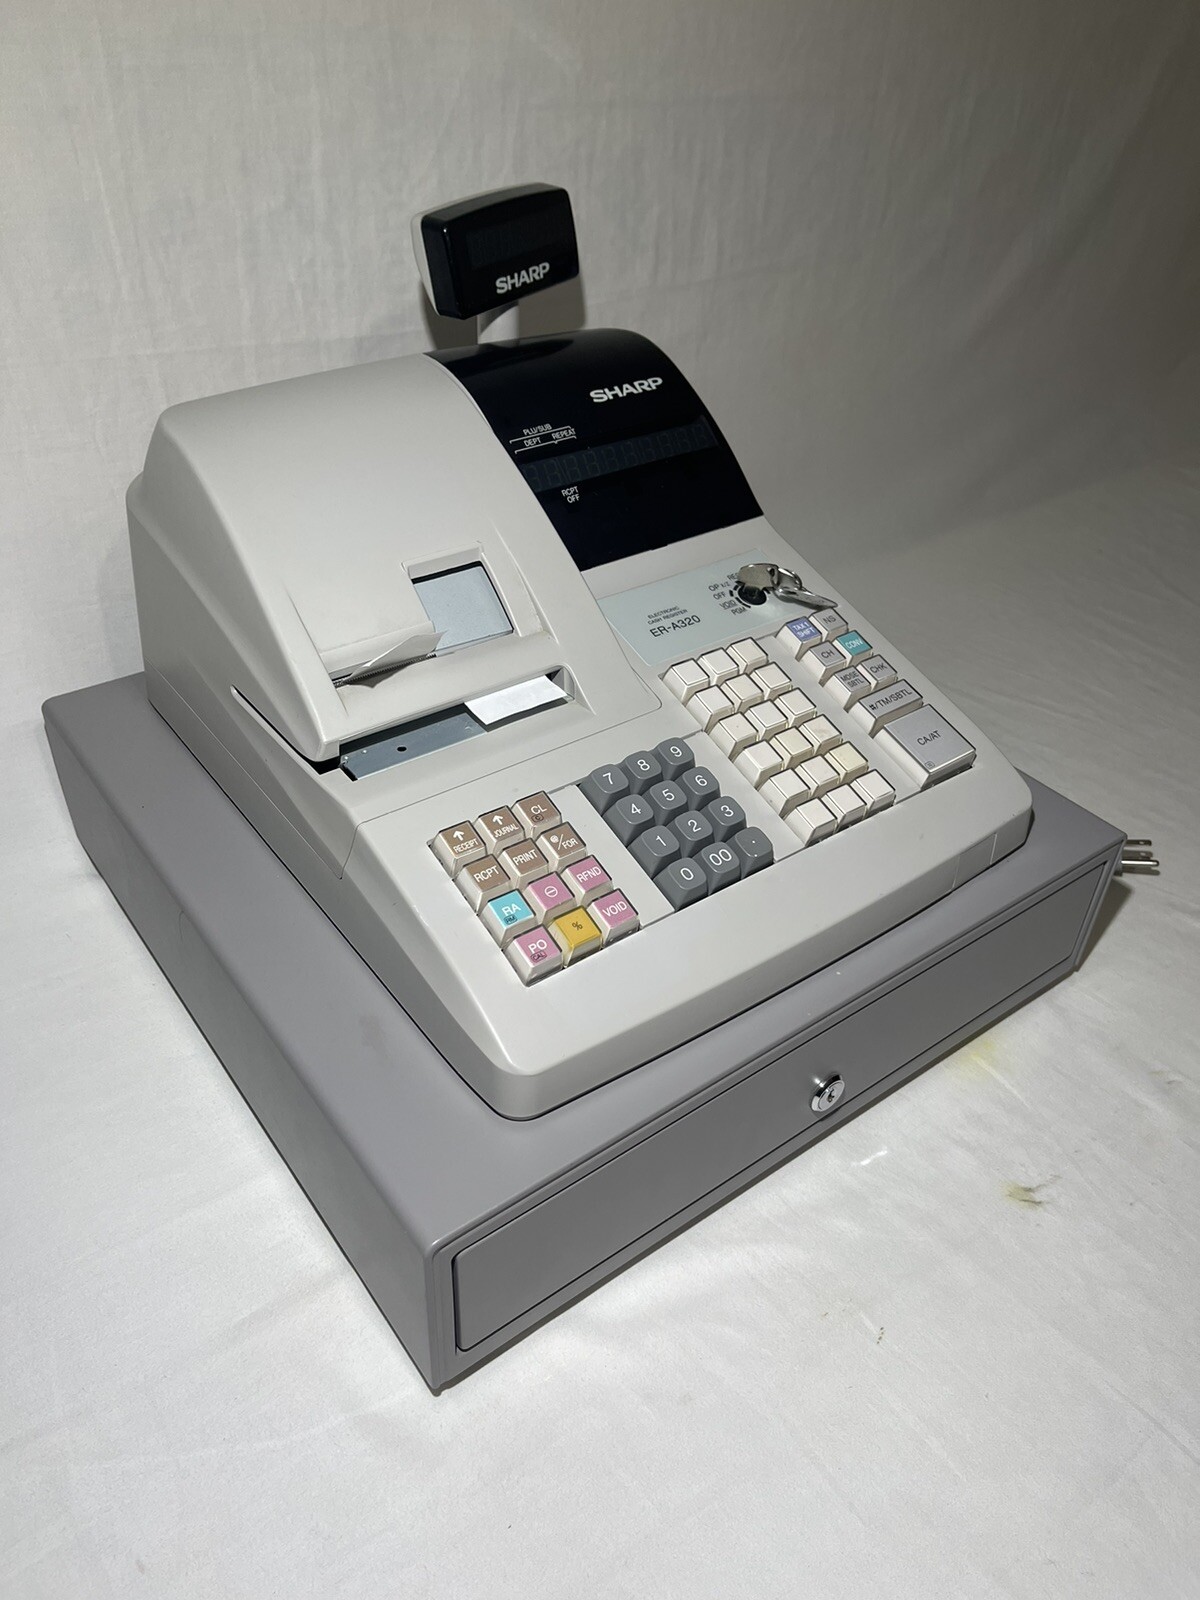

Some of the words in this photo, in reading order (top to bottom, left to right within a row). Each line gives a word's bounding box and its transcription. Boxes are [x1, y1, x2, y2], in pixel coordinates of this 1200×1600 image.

[495, 262, 550, 295] SHARP
[590, 377, 663, 403] SHARP
[522, 423, 552, 436] PLU/SUB
[551, 428, 576, 440] REPEAT
[523, 437, 541, 447] DEPT
[561, 486, 579, 497] RCPT
[566, 493, 580, 503] OFF
[708, 583, 720, 592] OP
[713, 591, 727, 600] OFF
[719, 599, 738, 610] VOID
[647, 606, 680, 619] ELECTRONIC
[647, 616, 663, 625] CASH
[663, 609, 688, 620] REGISTER
[730, 606, 748, 616] PGM
[822, 615, 836, 624] NS
[649, 614, 701, 638] ER-A320
[793, 623, 806, 631] TAX
[797, 627, 815, 638] SHIFT
[844, 639, 864, 649] CONV
[820, 650, 835, 660] CH
[869, 663, 887, 674] CHK
[847, 679, 864, 688] SBTL
[869, 688, 912, 711] #/TM/SBTL
[916, 730, 941, 746] CA/AT
[669, 746, 683, 758] 9
[637, 759, 650, 771] 8
[602, 772, 614, 785] 7
[694, 775, 708, 787] 6
[661, 788, 675, 801] 5
[530, 804, 548, 815] CL
[630, 803, 642, 816] 4
[720, 805, 734, 817] 3
[494, 823, 519, 838] JOURNAL
[687, 819, 701, 833] 2
[453, 838, 479, 853] RECEIPT
[655, 835, 667, 847] 1
[512, 849, 538, 865] PRINT
[709, 848, 732, 866] 00
[473, 865, 499, 883] RCPT
[576, 866, 602, 883] RFND
[680, 867, 694, 881] 0
[501, 904, 521, 917] RA
[602, 901, 628, 917] VOID
[571, 921, 583, 931] %
[528, 939, 547, 954] PO
